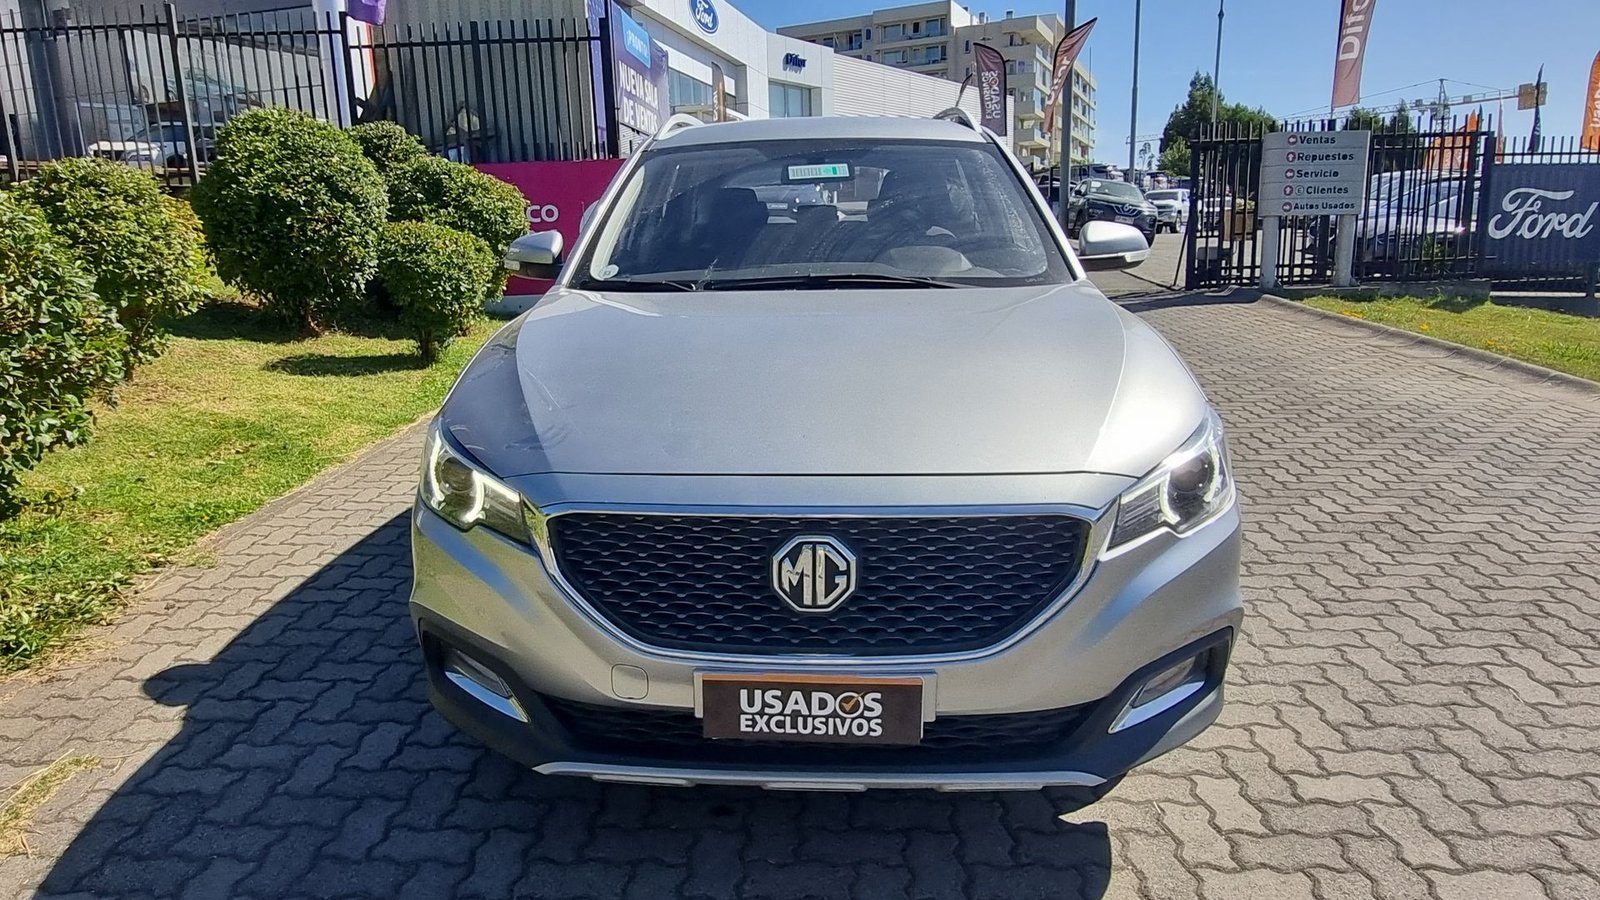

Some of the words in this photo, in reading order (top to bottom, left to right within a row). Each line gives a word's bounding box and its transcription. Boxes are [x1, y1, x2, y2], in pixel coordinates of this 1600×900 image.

[695, 0, 714, 28] Ford
[619, 60, 644, 101] NUEVA
[645, 79, 658, 110] SALA
[623, 95, 635, 125] DE
[635, 102, 658, 136] VENTAS
[1299, 136, 1336, 145] Ventas
[1297, 152, 1355, 163] Repuestos
[1296, 169, 1340, 178] Servicio
[1306, 186, 1349, 194] Clientes
[1293, 202, 1319, 210] Autos
[1488, 187, 1599, 240] Ford
[781, 543, 847, 606] MG
[739, 689, 883, 718] USADOS
[739, 714, 883, 737] EXCLUSIVOS
